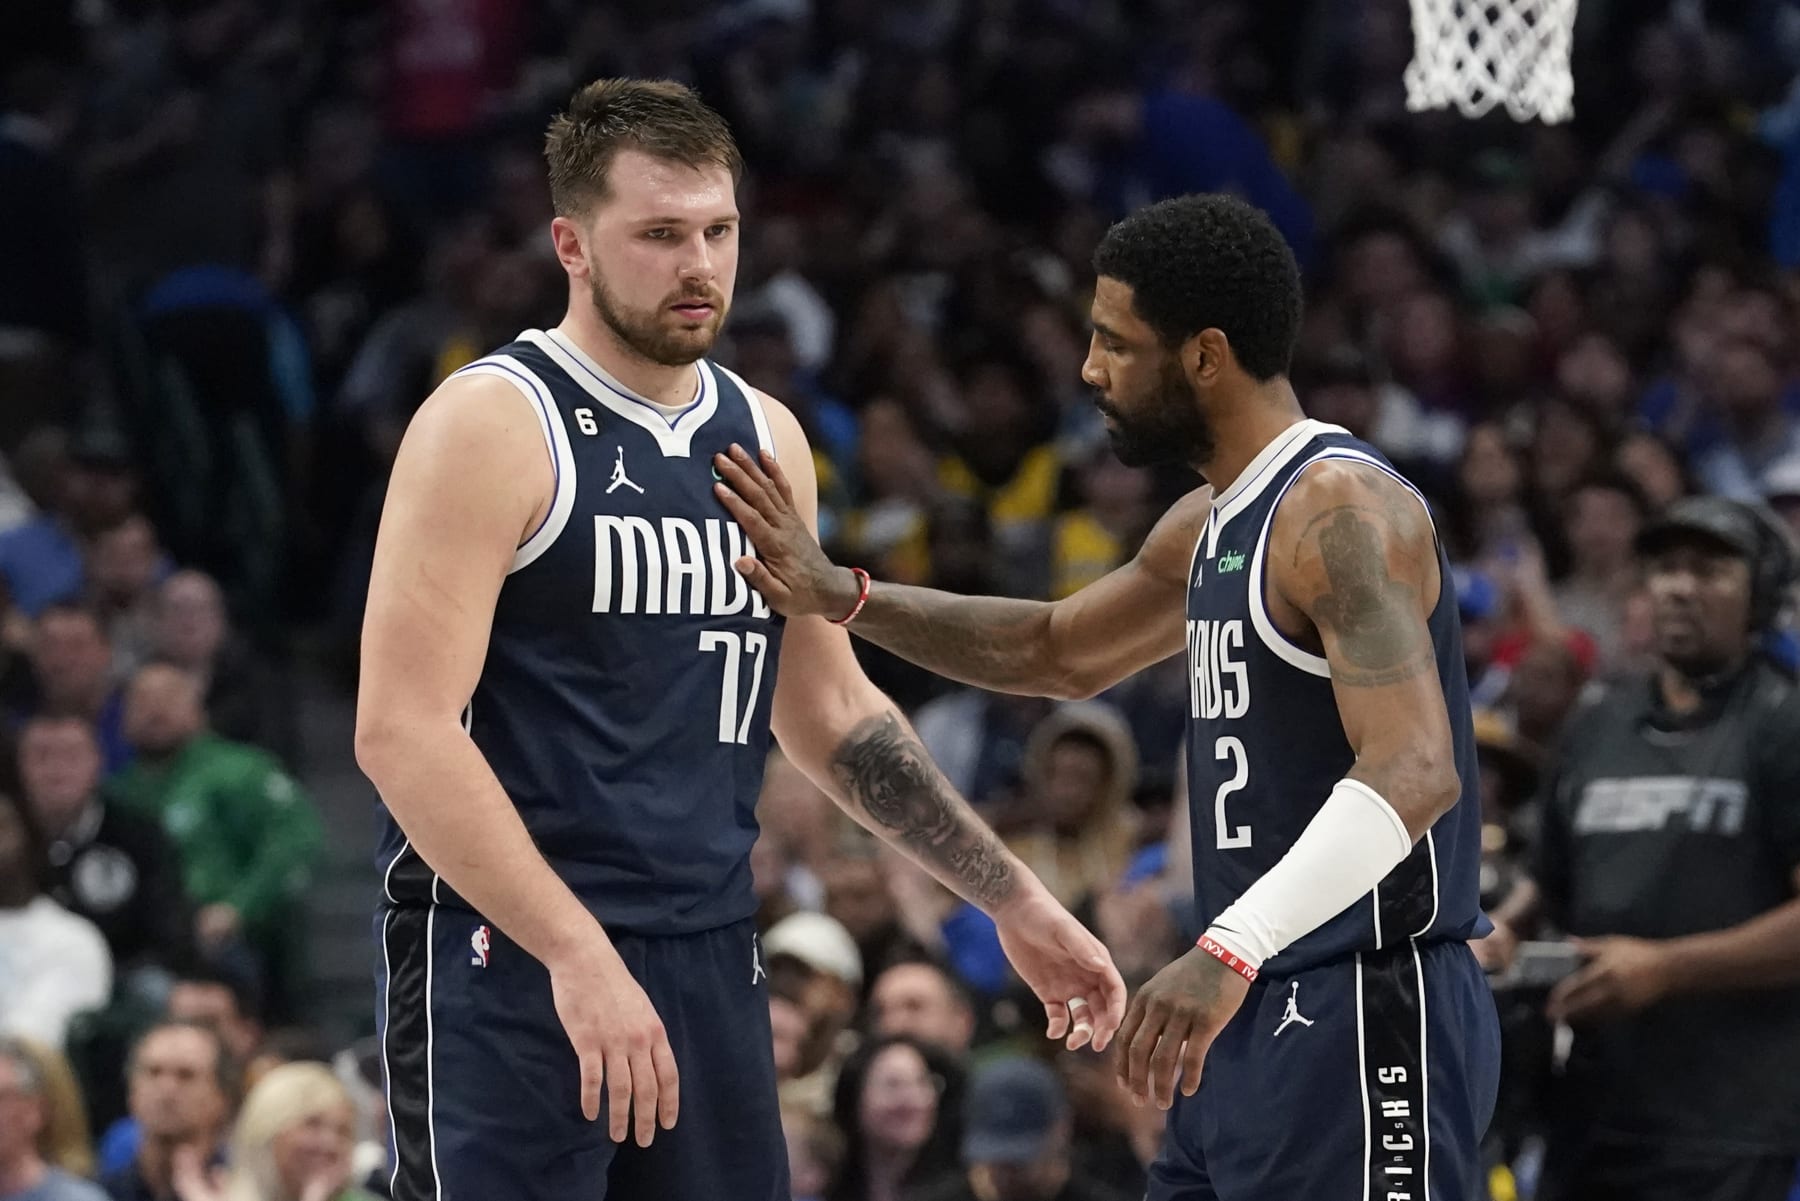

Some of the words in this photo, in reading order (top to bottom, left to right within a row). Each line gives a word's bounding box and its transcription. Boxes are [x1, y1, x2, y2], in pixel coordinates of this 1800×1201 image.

[574, 407, 599, 436] 6
[1218, 550, 1246, 574] chime
[698, 630, 767, 745] 77
[1215, 736, 1252, 849] 2
